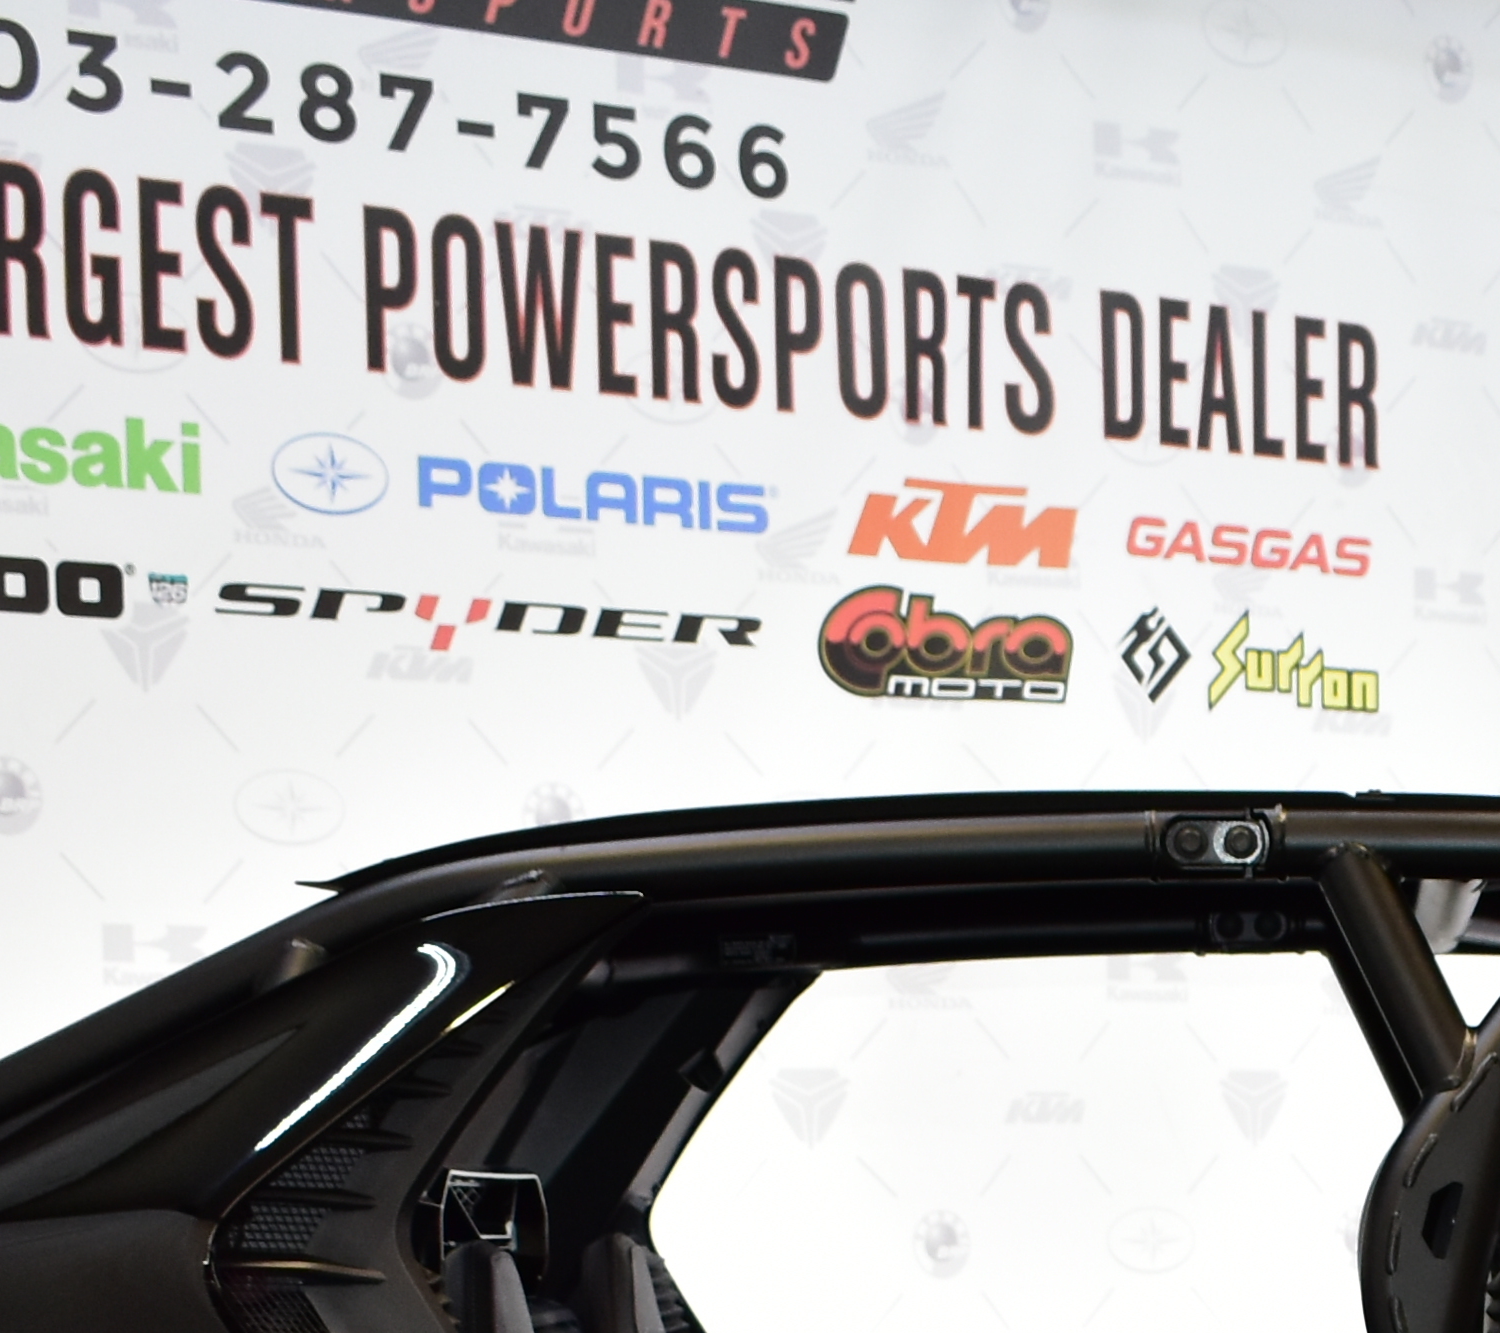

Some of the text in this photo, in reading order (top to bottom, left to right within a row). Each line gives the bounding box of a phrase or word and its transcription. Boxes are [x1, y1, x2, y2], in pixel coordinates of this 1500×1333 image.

[361, 203, 1056, 437] POWERSPORTS
[1098, 288, 1381, 471] DEALER
[417, 455, 769, 535] POLARIS
[846, 477, 1077, 569] KTM
[1126, 515, 1372, 577] GASGAS
[214, 581, 763, 651] SPYDER
[818, 584, 1073, 698] Cobra
[886, 677, 1068, 702] MOTO
